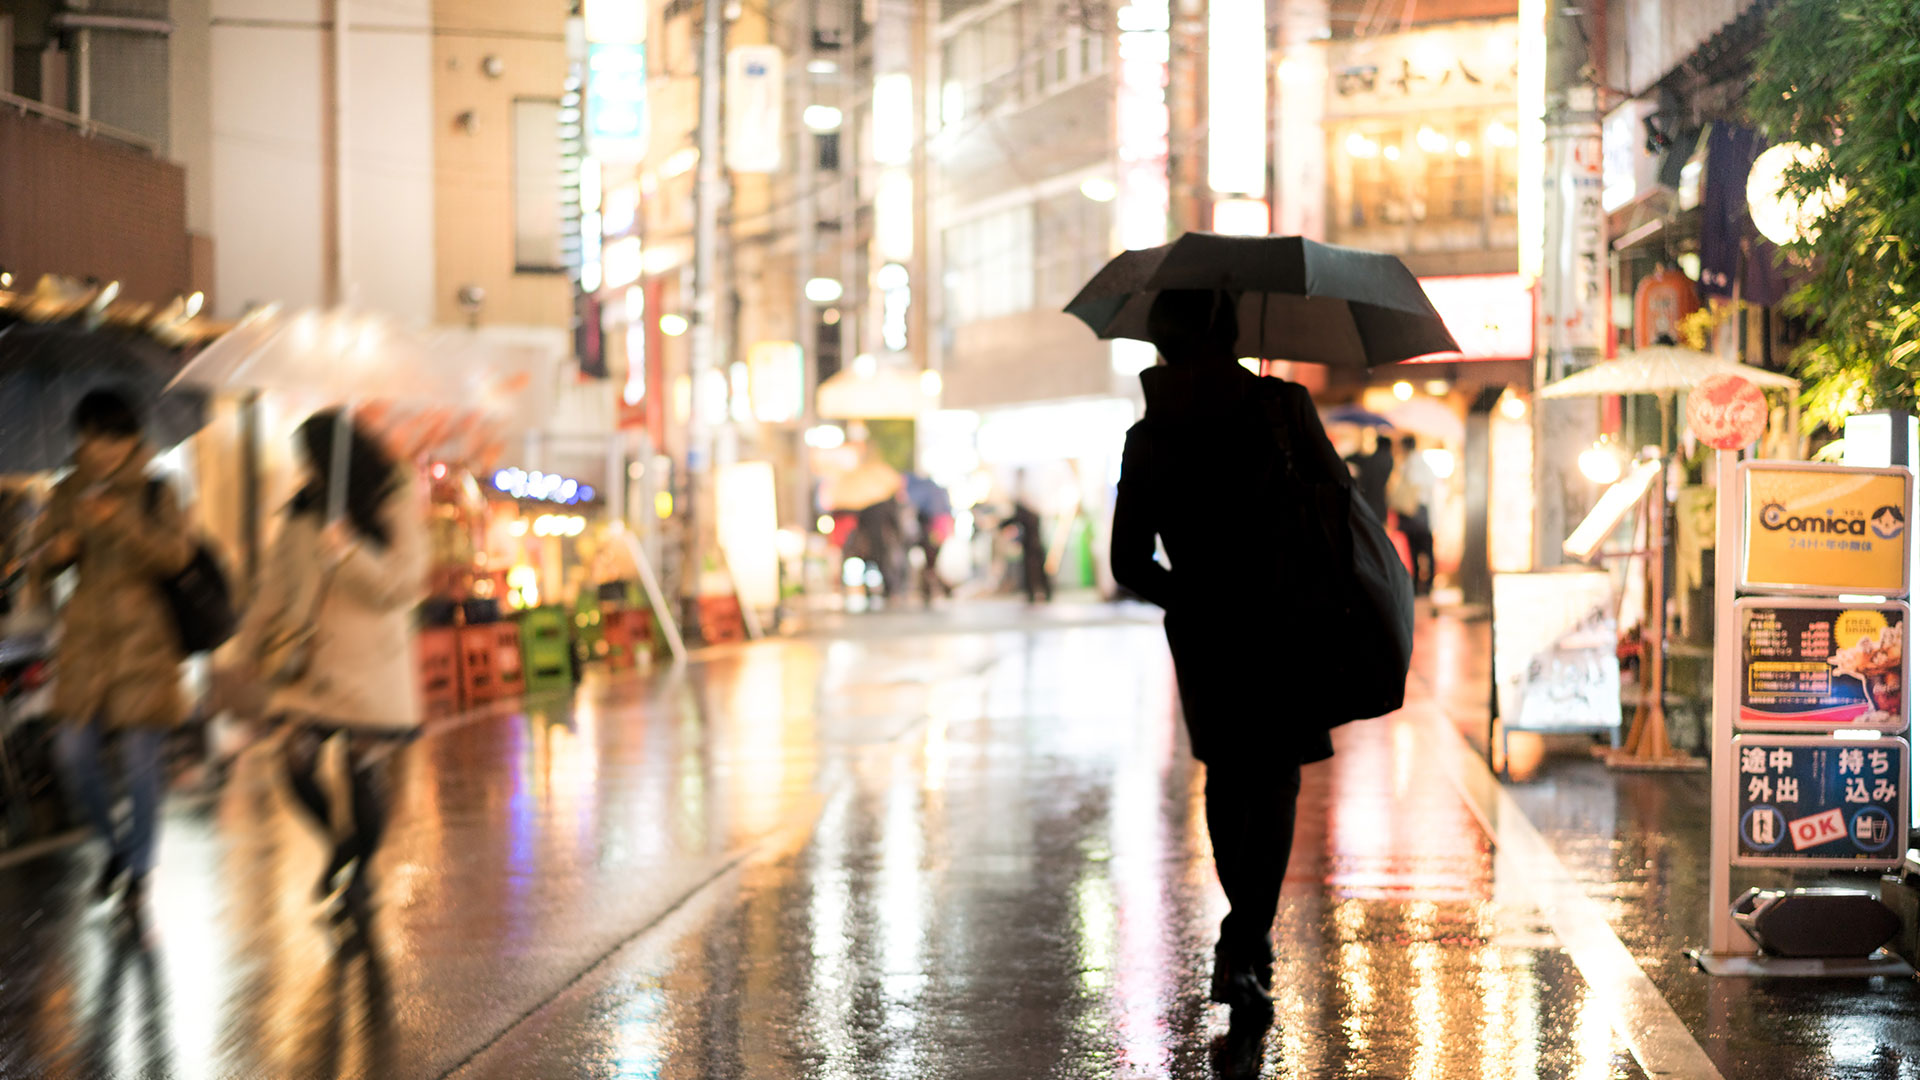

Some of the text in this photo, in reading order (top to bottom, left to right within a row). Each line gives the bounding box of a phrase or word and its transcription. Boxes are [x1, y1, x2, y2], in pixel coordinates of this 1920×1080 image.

[1759, 502, 1866, 536] Comica
[1741, 747, 1793, 774] 途中
[1838, 748, 1889, 775] 持ち
[1748, 775, 1799, 803] 外出
[1845, 777, 1897, 803] 込み
[1798, 815, 1838, 842] OK
